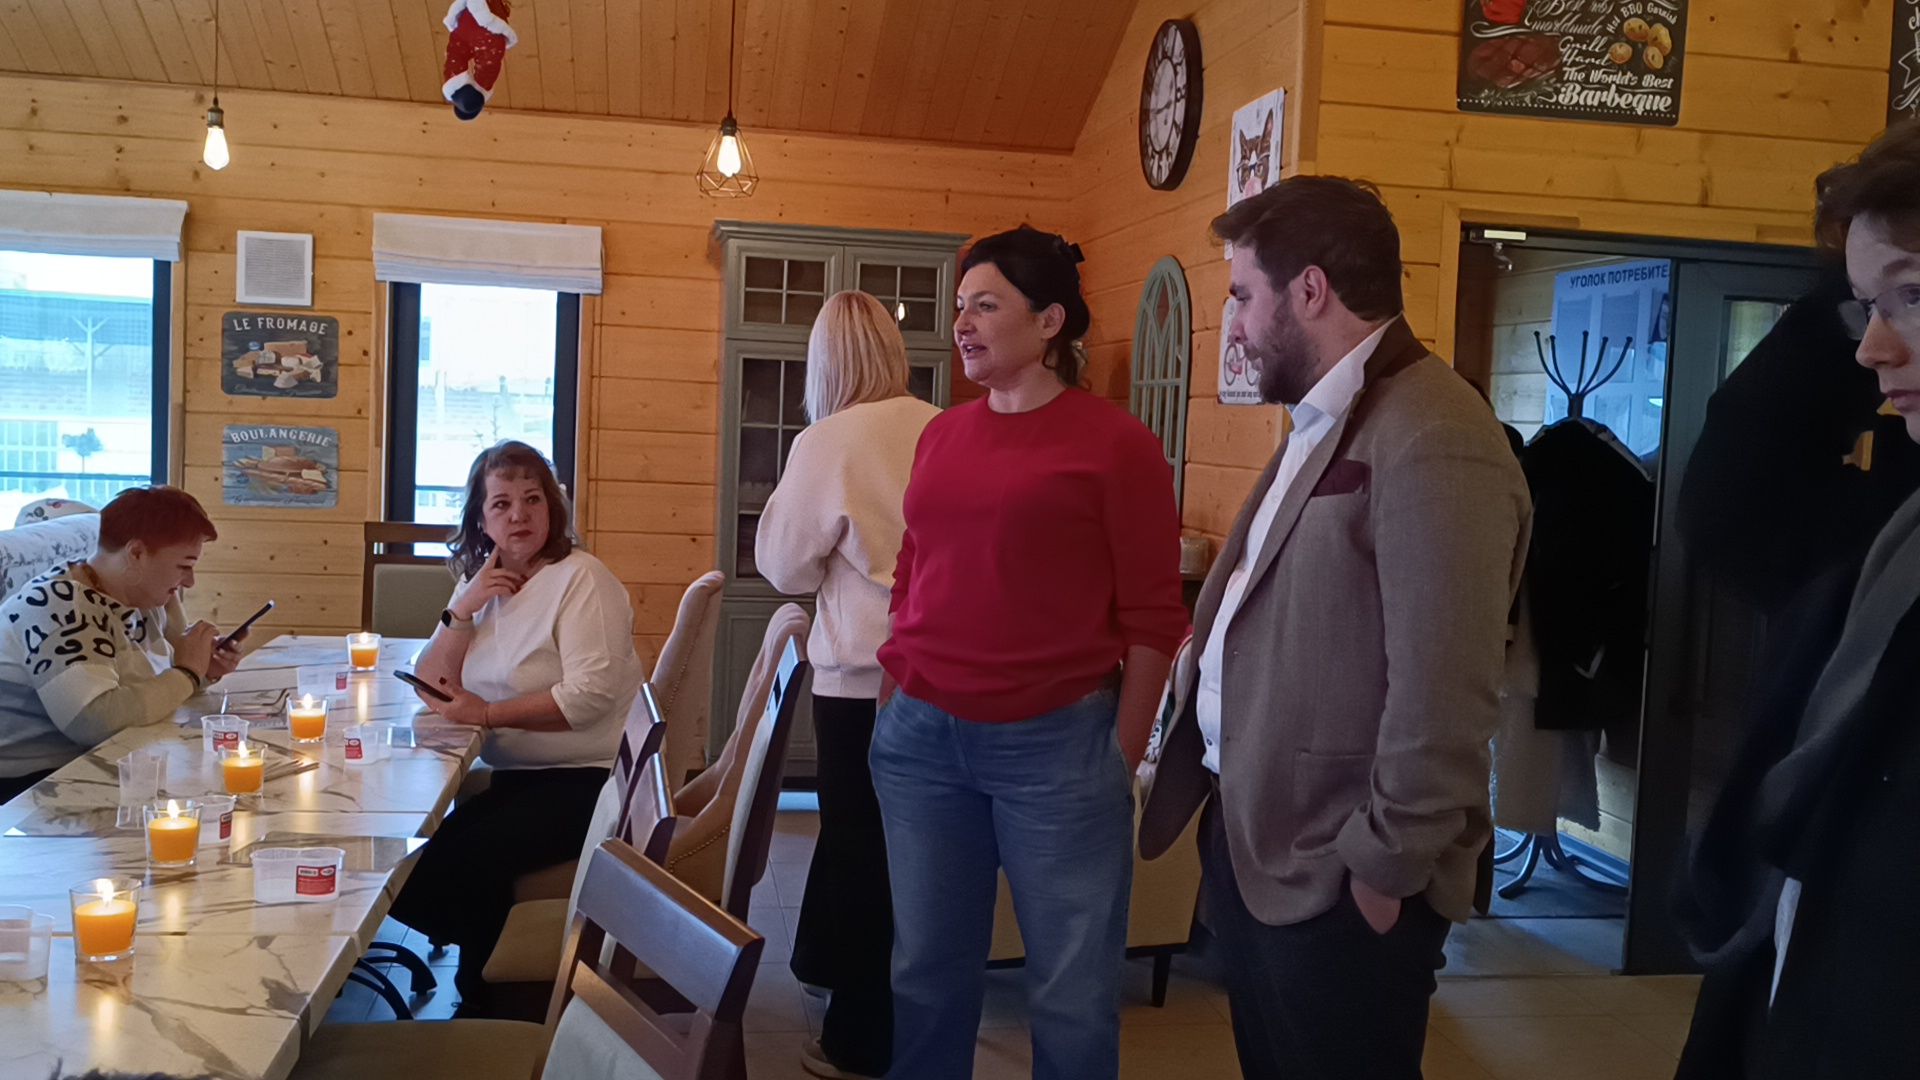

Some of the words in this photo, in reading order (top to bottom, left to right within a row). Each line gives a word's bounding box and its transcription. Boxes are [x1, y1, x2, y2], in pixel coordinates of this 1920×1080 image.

[1606, 16, 1622, 34] Hot
[1621, 4, 1643, 18] BBQ
[1646, 3, 1678, 25] Garnish
[1558, 35, 1609, 54] Grill
[1562, 66, 1587, 82] The
[1590, 69, 1638, 86] World's
[1641, 74, 1674, 89] Best
[1557, 83, 1673, 115] Barbeque
[1570, 273, 1606, 288] УГОЛОК
[1608, 264, 1670, 284] ПОТРЕБИТЕ
[232, 317, 252, 331] LE
[257, 317, 329, 335] FROMAGE
[230, 428, 332, 447] BOULANGERIE
